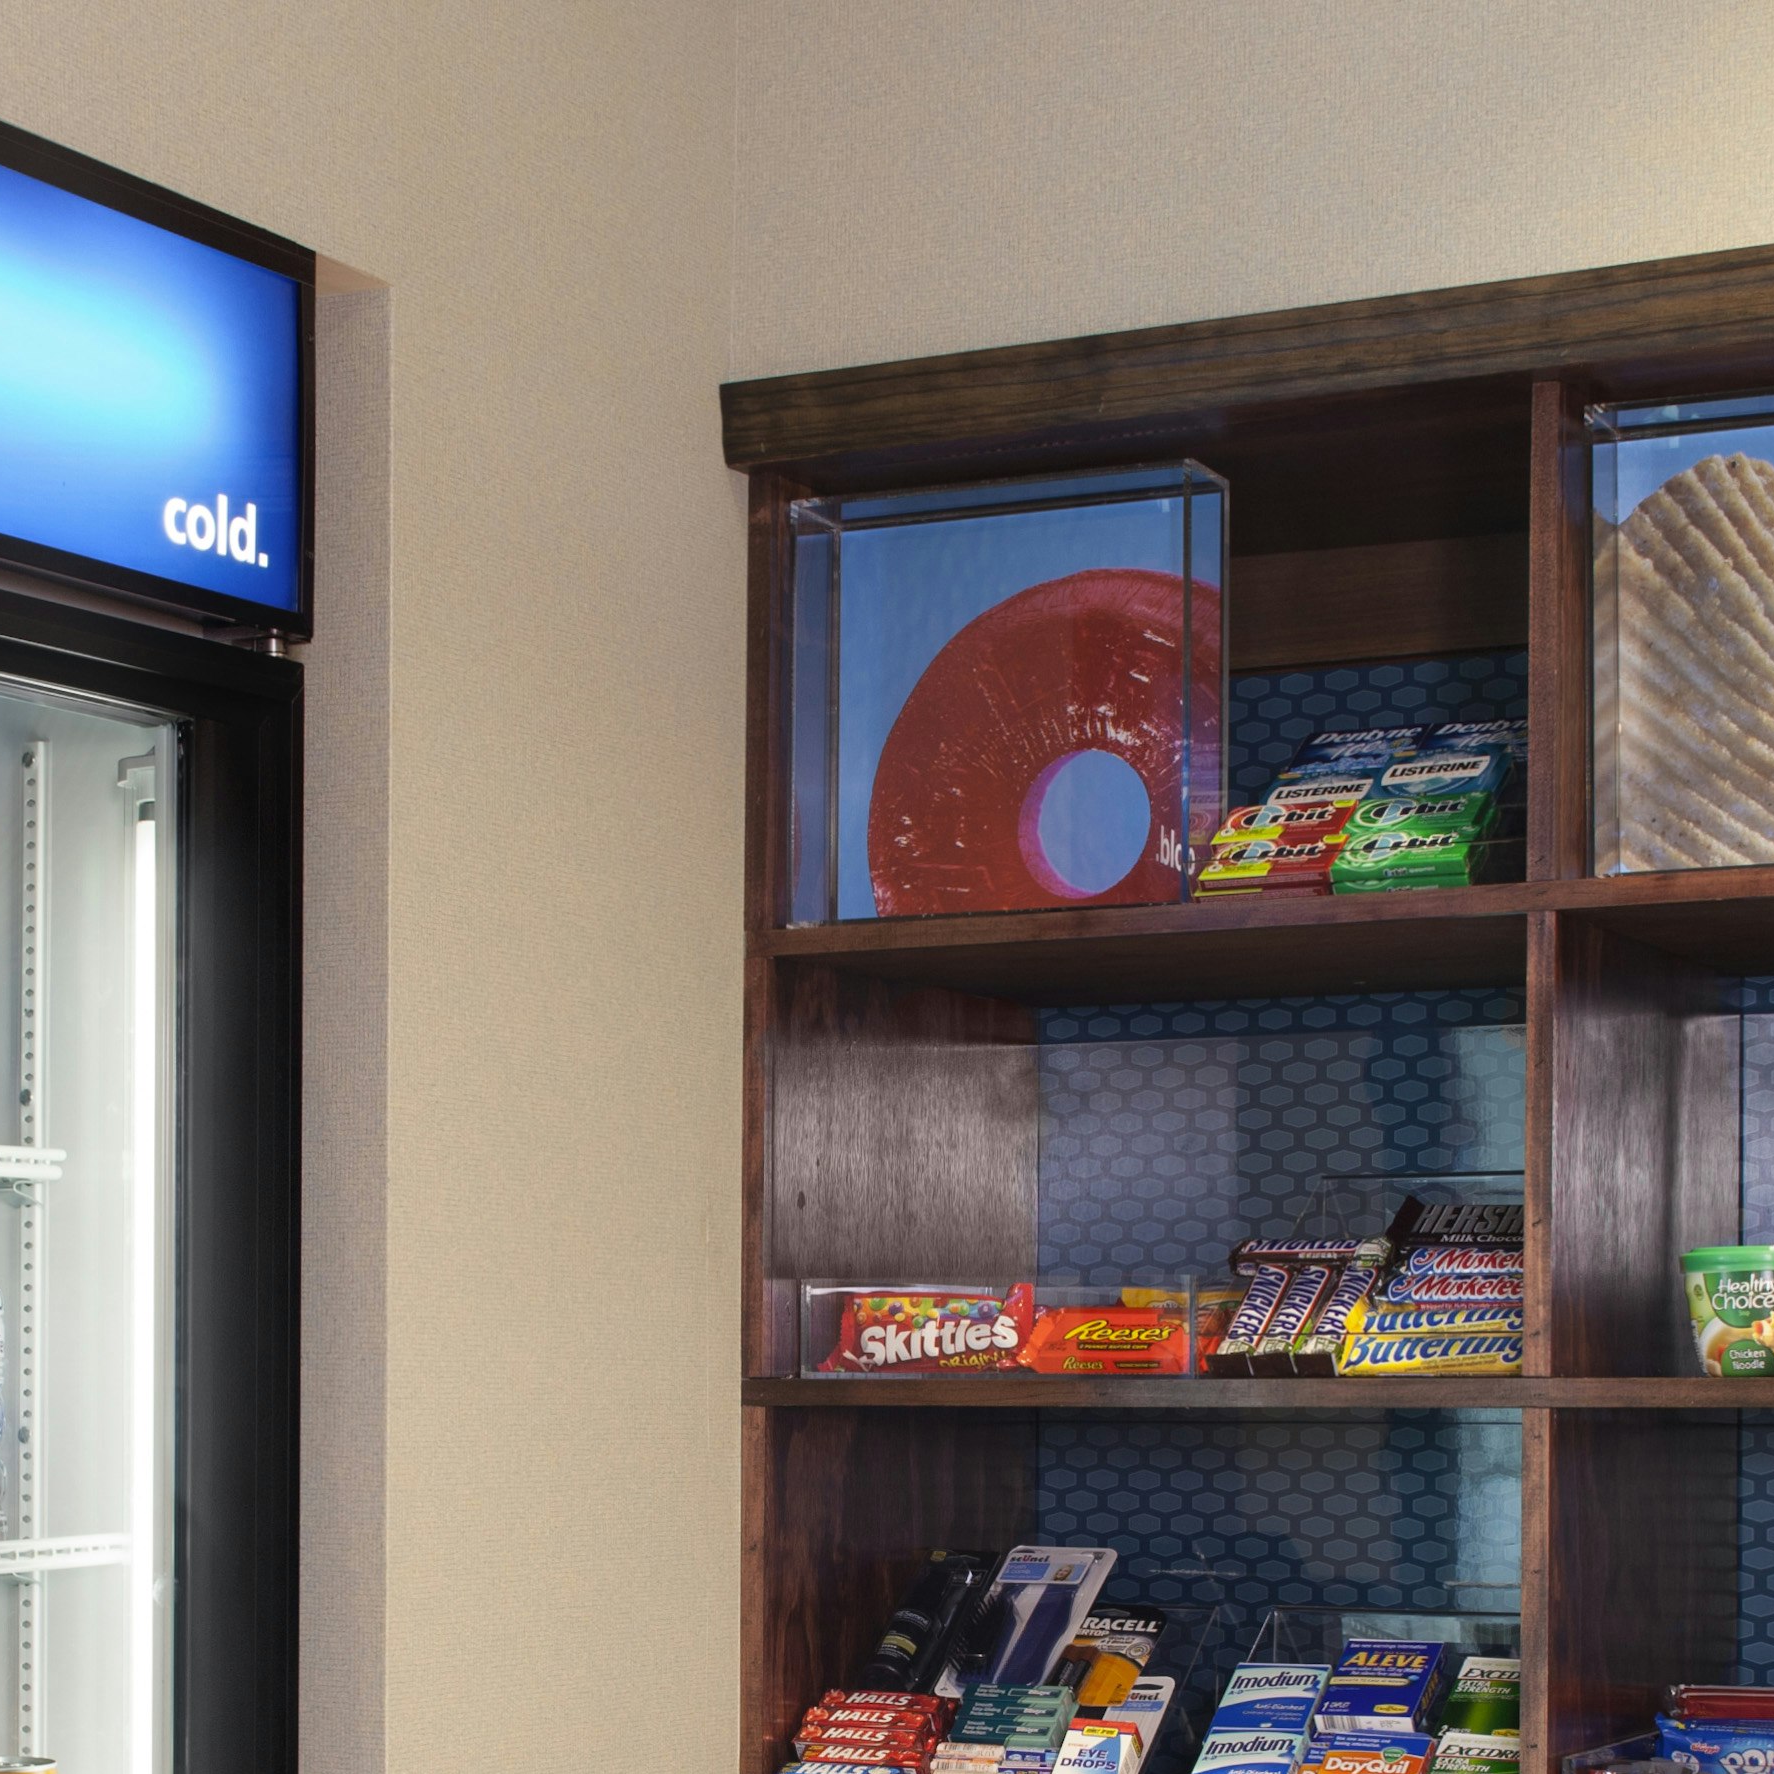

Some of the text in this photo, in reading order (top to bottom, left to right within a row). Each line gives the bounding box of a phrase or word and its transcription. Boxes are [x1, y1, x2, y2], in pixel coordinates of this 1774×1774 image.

[163, 494, 269, 567] cold.
[1314, 726, 1423, 745] Dentyne
[1389, 759, 1484, 779] LISTERINE
[1275, 782, 1366, 800] LISTERINE
[1228, 1266, 1287, 1344] SNICKERS
[1269, 1266, 1327, 1343] SNICKERS
[1064, 1320, 1174, 1342] Reese's
[860, 1315, 1018, 1367] Skittles
[1729, 1349, 1766, 1359] Chicken
[1732, 1359, 1766, 1370] Noodle
[1344, 1651, 1428, 1668] ALEVE
[1231, 1671, 1318, 1689] Imodium
[1454, 1680, 1491, 1689] EXTRA
[1455, 1686, 1512, 1694] STRENGTH
[845, 1691, 910, 1706] HALLS
[828, 1709, 895, 1723] HALLS
[821, 1727, 888, 1741] HALLS
[818, 1746, 888, 1760] HALLS
[1077, 1748, 1109, 1760] EYE
[1206, 1738, 1294, 1755] Imodium
[1060, 1756, 1117, 1771] DROPS
[1325, 1757, 1409, 1774] DayQuil
[1433, 1762, 1491, 1772] STRENGTH
[1434, 1758, 1470, 1766] EXTRA
